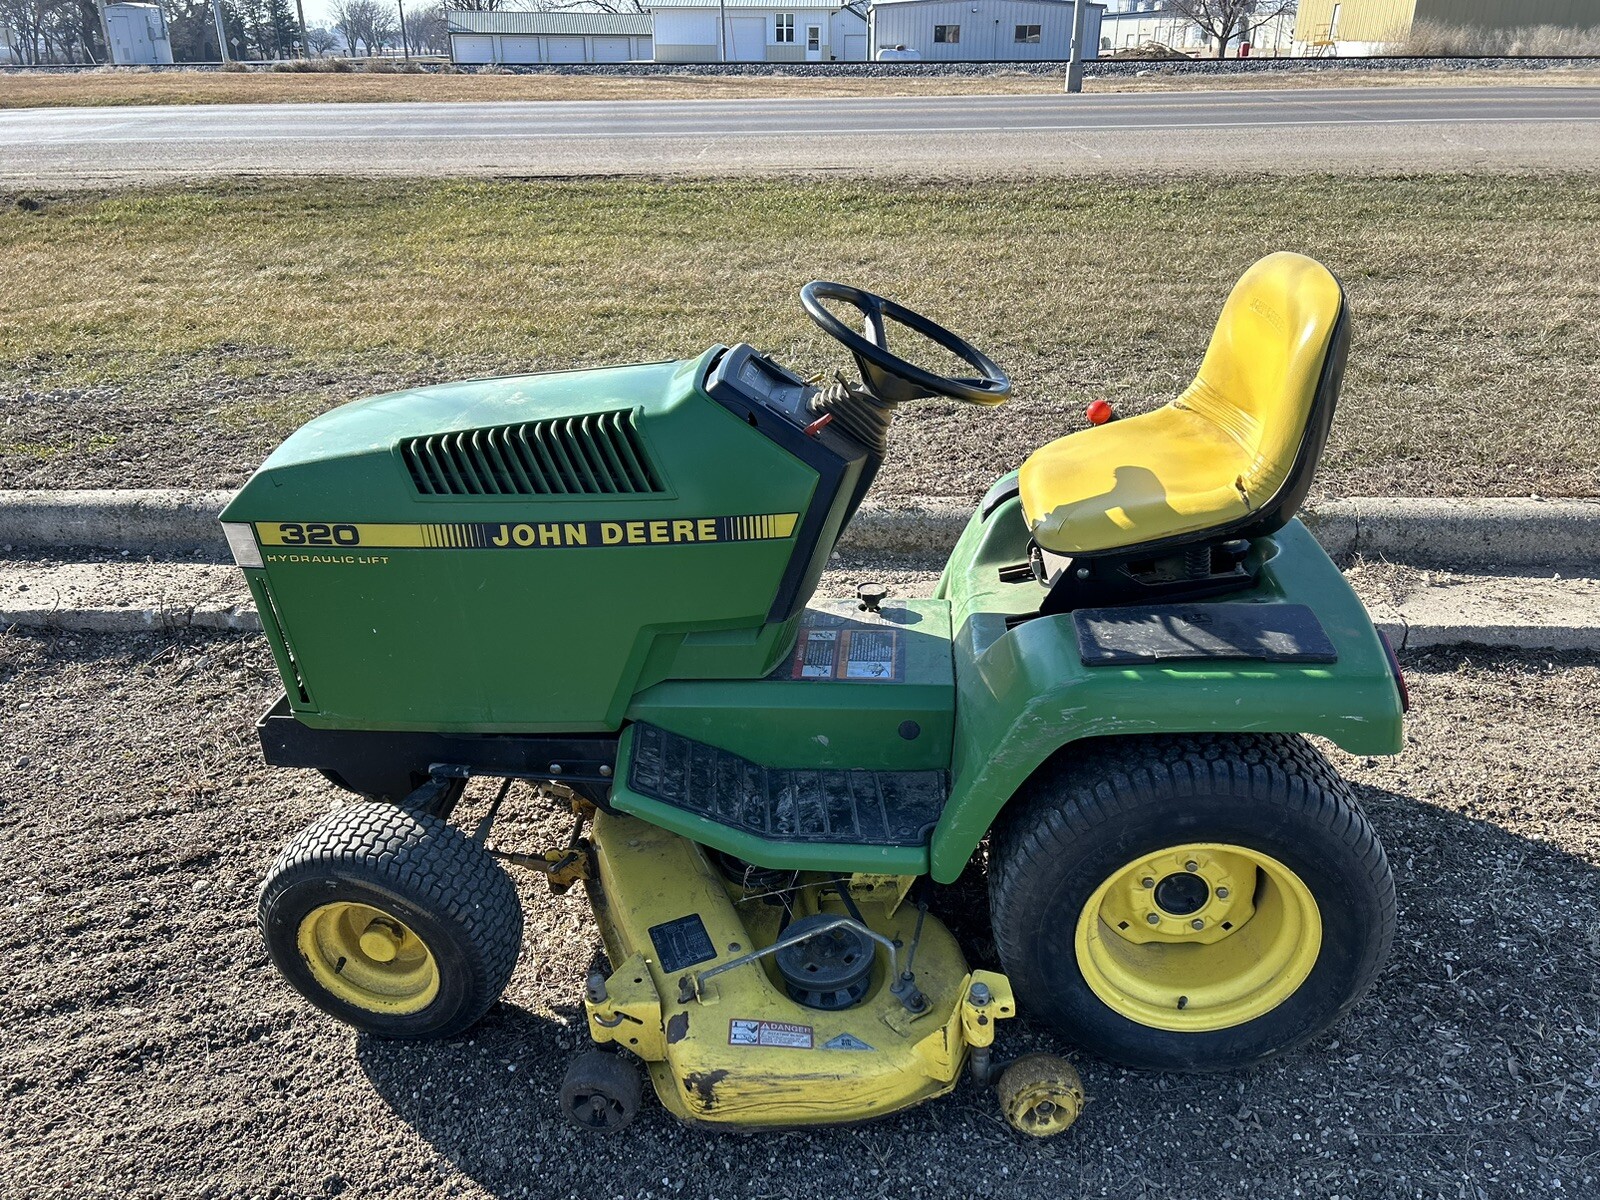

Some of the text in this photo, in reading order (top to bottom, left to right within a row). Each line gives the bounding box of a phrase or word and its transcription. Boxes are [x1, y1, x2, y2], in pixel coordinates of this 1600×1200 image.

[279, 523, 360, 546] 320
[491, 518, 718, 547] JOHN DEERE
[266, 554, 389, 565] HYDRAULIC LIFT
[769, 1022, 812, 1034] DANGER
